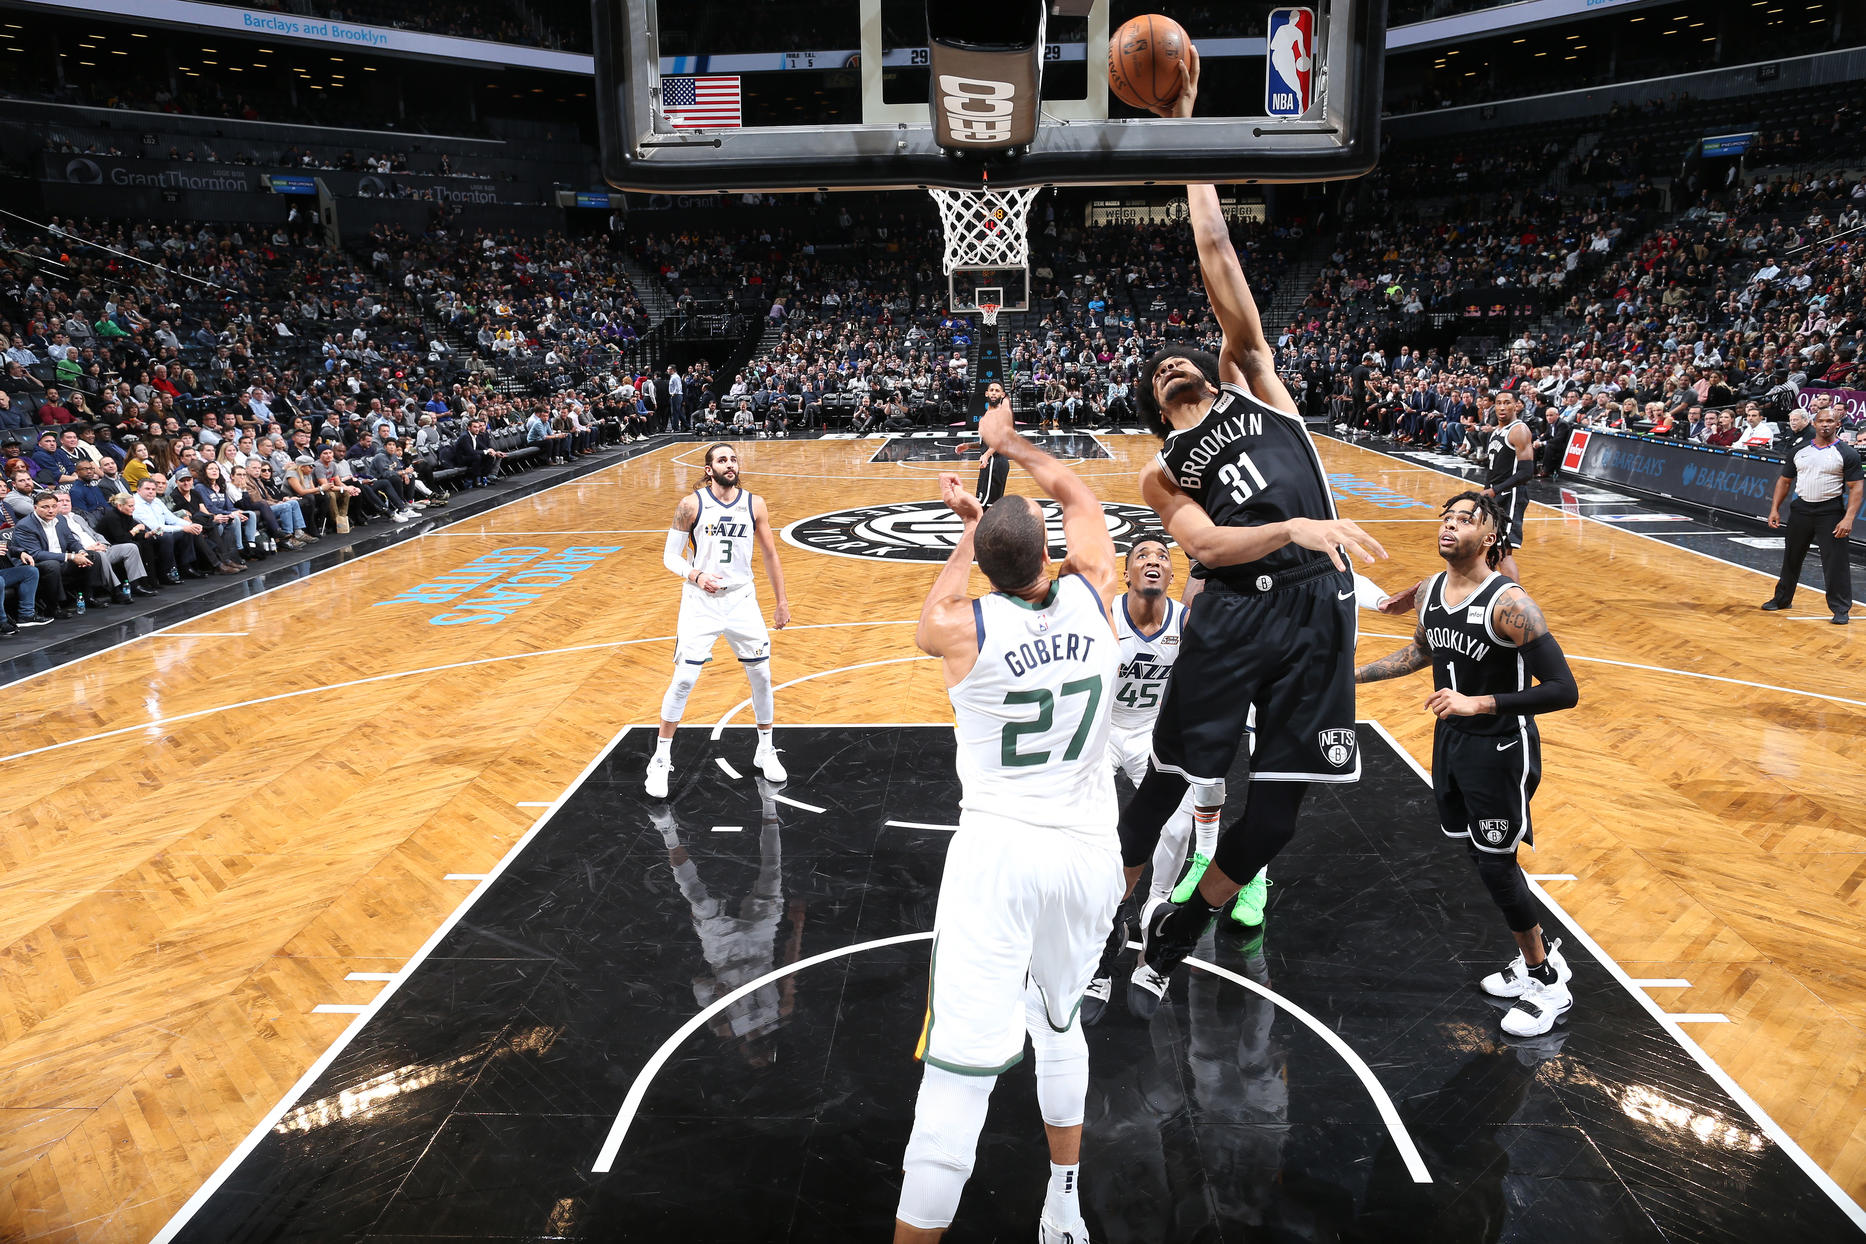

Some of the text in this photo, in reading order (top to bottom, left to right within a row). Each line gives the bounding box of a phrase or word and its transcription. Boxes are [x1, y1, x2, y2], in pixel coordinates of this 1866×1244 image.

[243, 13, 387, 45] Barclays and Brooklyn
[808, 59, 813, 67] 5
[911, 49, 929, 64] 29
[1044, 46, 1061, 60] 29
[939, 75, 1015, 142] GEICO
[1272, 93, 1294, 110] NBA
[1180, 413, 1263, 489] BROOKLYN
[1612, 448, 1666, 477] BARCLAYS
[1218, 451, 1268, 505] 31
[1695, 466, 1769, 499] BARCLAYS
[705, 516, 748, 538] JAZZ
[719, 539, 733, 563] 3
[803, 528, 907, 556] YORK
[372, 546, 550, 607] CENTER
[428, 546, 624, 626] BARCLAYS
[1468, 611, 1484, 619] infor
[1004, 633, 1095, 677] GOBERT
[1446, 661, 1458, 692] 1
[1116, 682, 1161, 709] 45
[1001, 674, 1103, 767] 27
[1321, 730, 1353, 747] NETS
[1481, 820, 1508, 831] NETS
